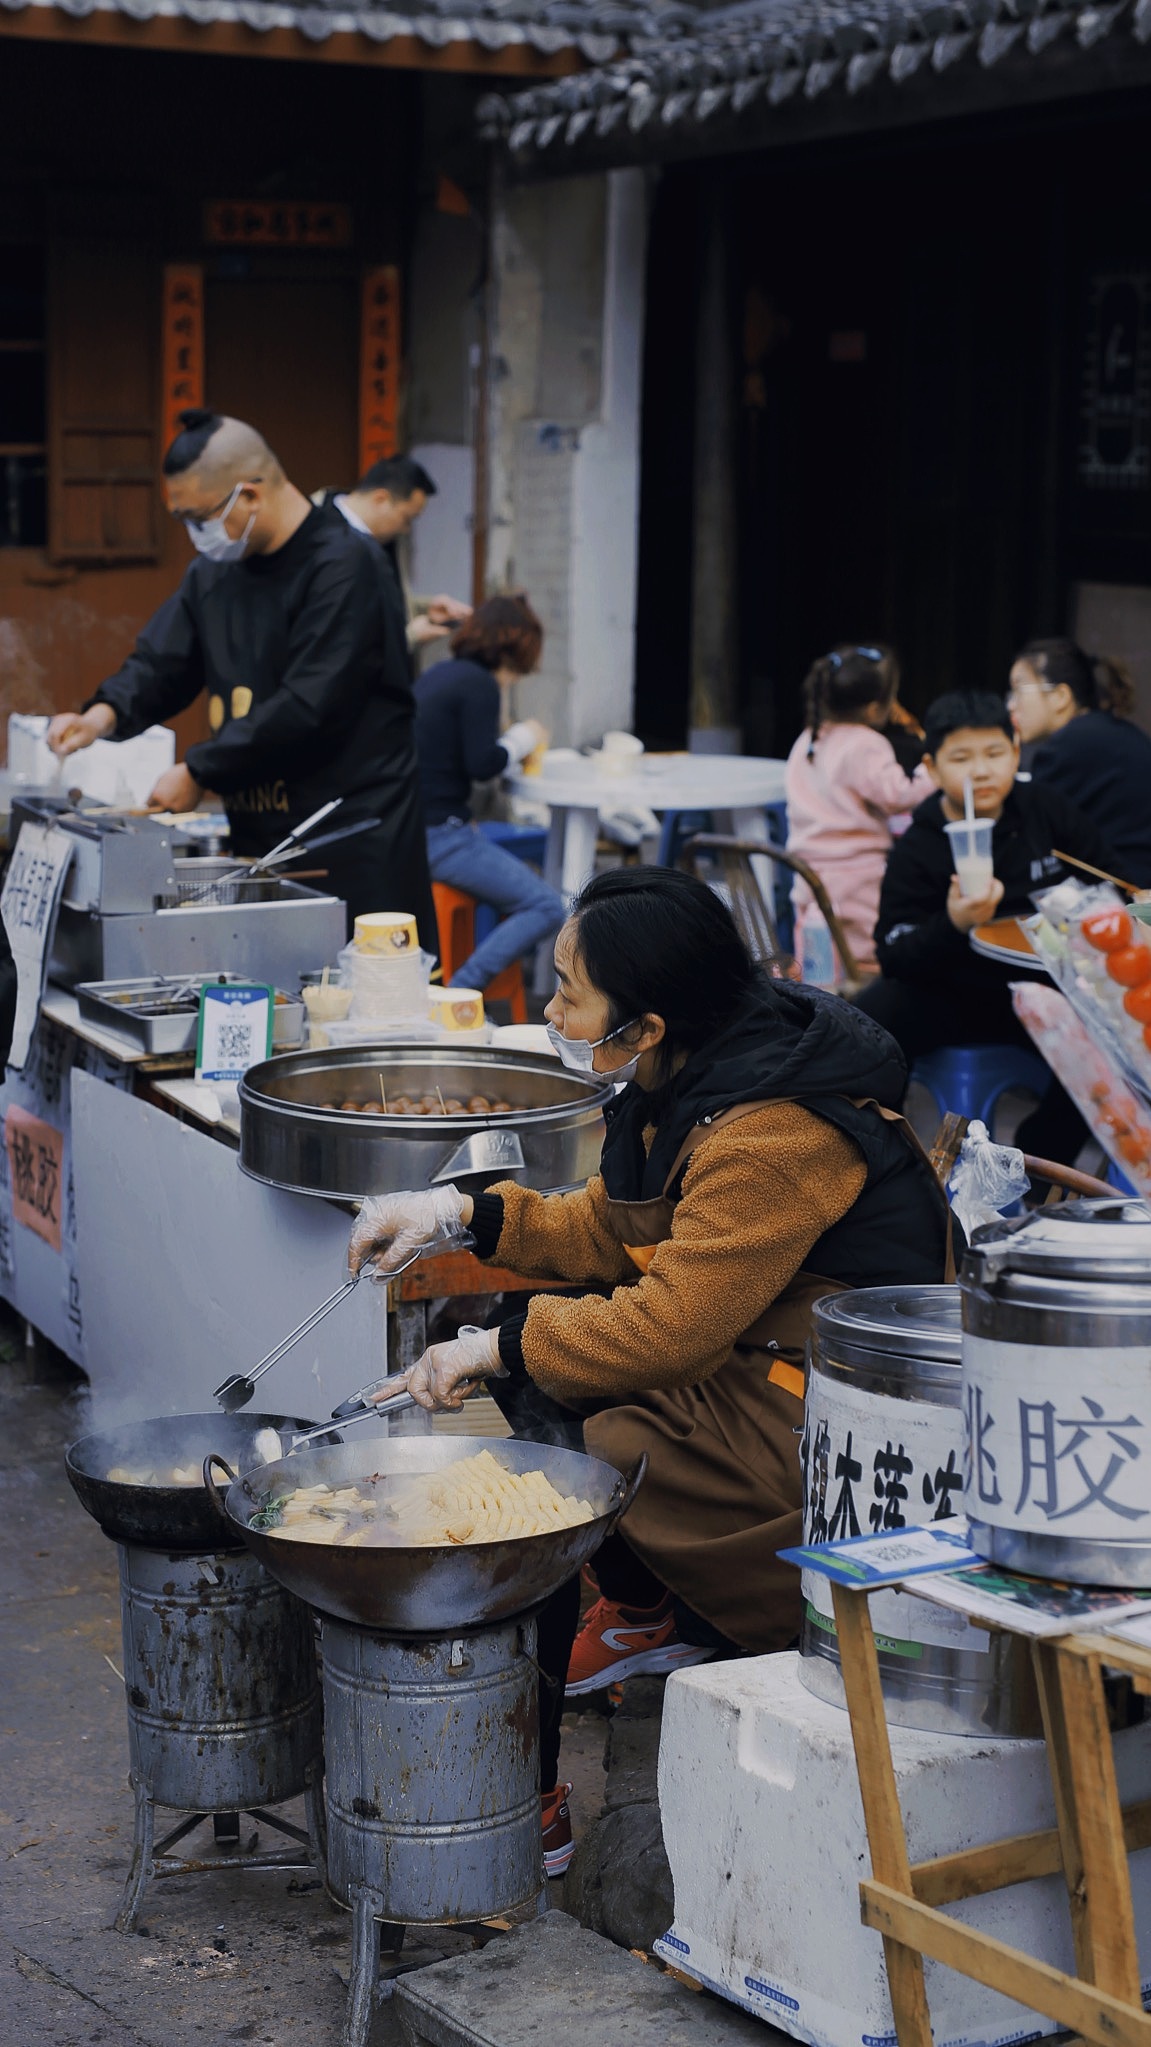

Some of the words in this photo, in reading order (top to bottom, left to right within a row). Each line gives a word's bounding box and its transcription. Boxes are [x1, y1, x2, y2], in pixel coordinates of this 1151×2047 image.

[225, 779, 289, 813] KING
[12, 1124, 58, 1224] 桃胶
[801, 1418, 963, 1546] 镇木莲
